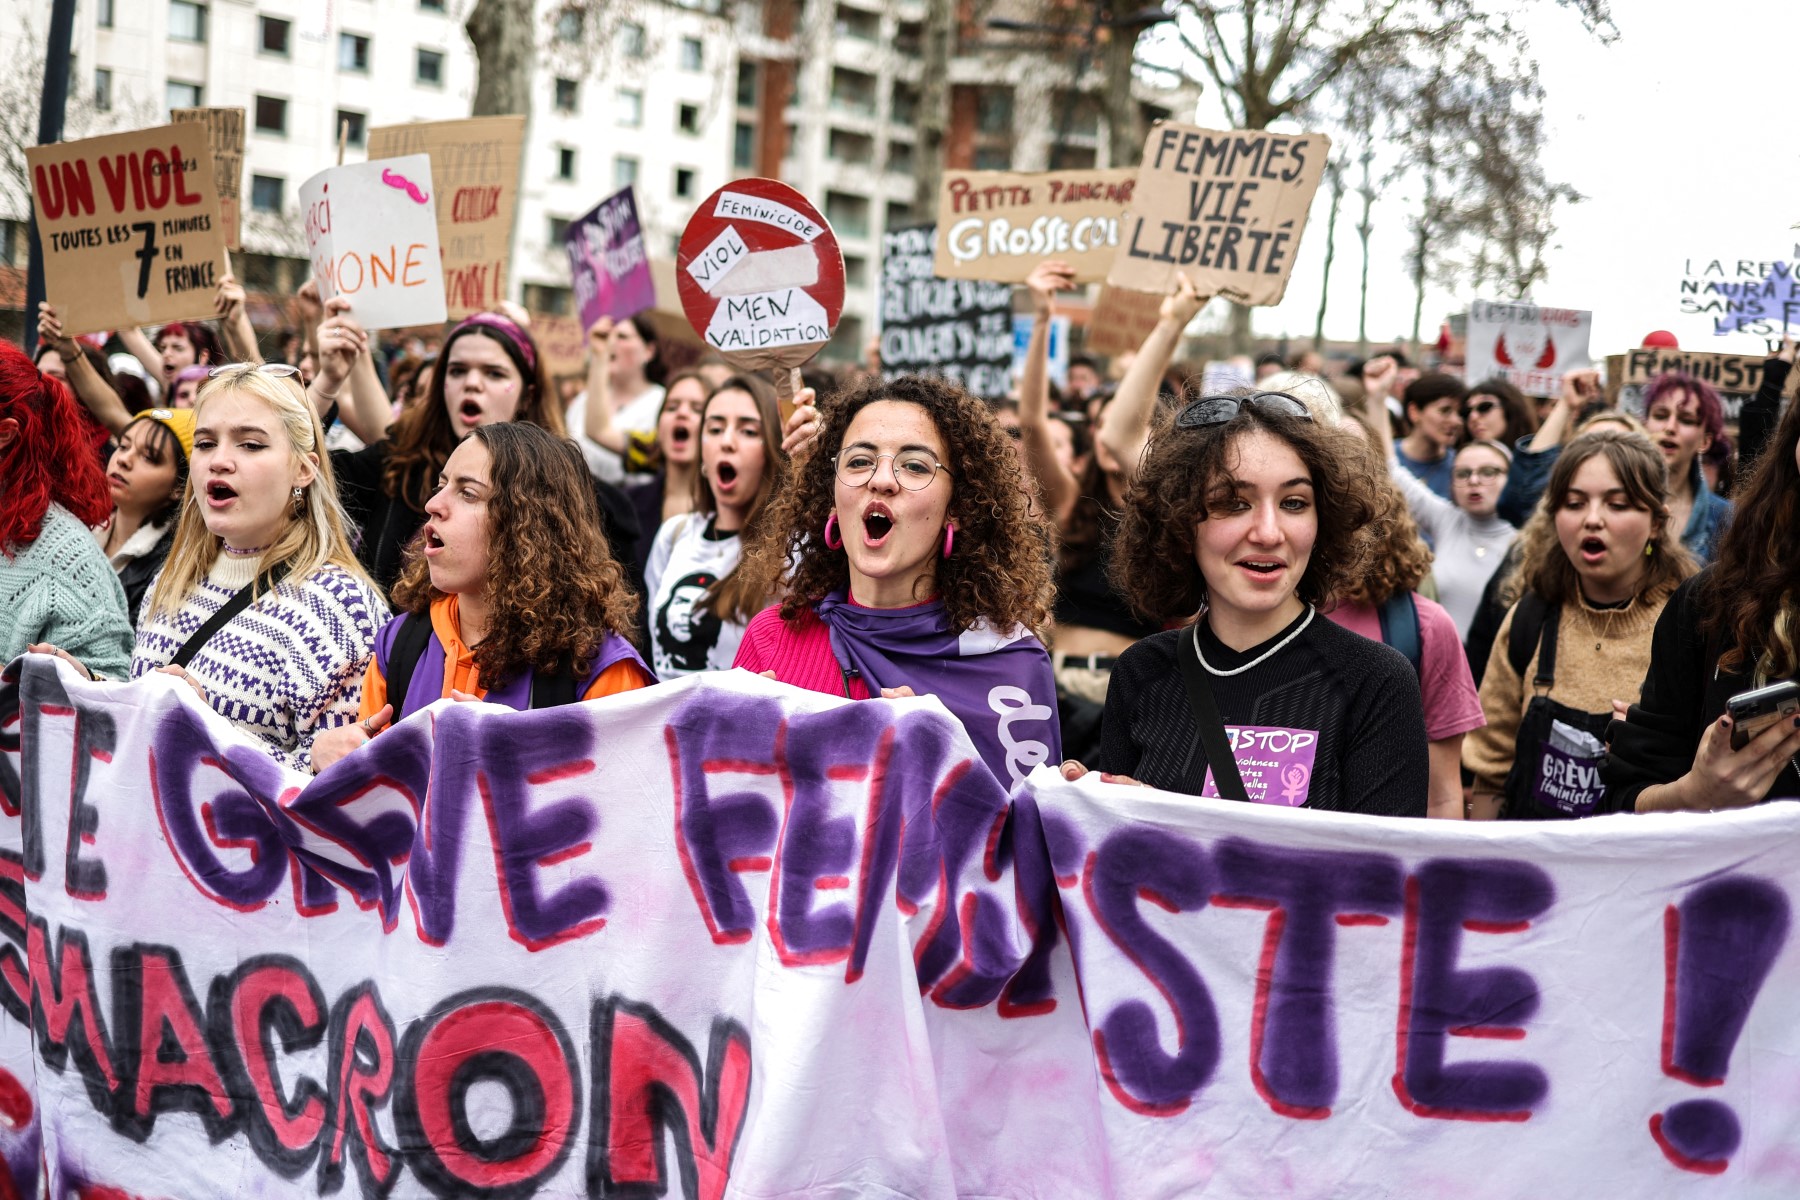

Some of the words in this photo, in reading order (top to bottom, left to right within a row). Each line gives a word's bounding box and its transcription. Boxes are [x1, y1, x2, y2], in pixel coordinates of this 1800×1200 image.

[1154, 129, 1309, 188] FEMMES,
[35, 158, 96, 221] UN
[98, 144, 203, 214] VIOL
[1048, 179, 1136, 206] PANCAR
[51, 228, 103, 253] TOUTES
[107, 224, 131, 245] LES
[131, 220, 160, 300] 7
[163, 214, 212, 238] MINUTES
[165, 243, 184, 262] EN
[1128, 216, 1296, 275] LIBERTÉ
[165, 260, 216, 296] FRANCE
[727, 289, 793, 321] MEN
[1680, 297, 1766, 316] SANS
[1713, 316, 1774, 336] LES
[1238, 729, 1315, 754] STOP
[1647, 872, 1793, 1175] !
